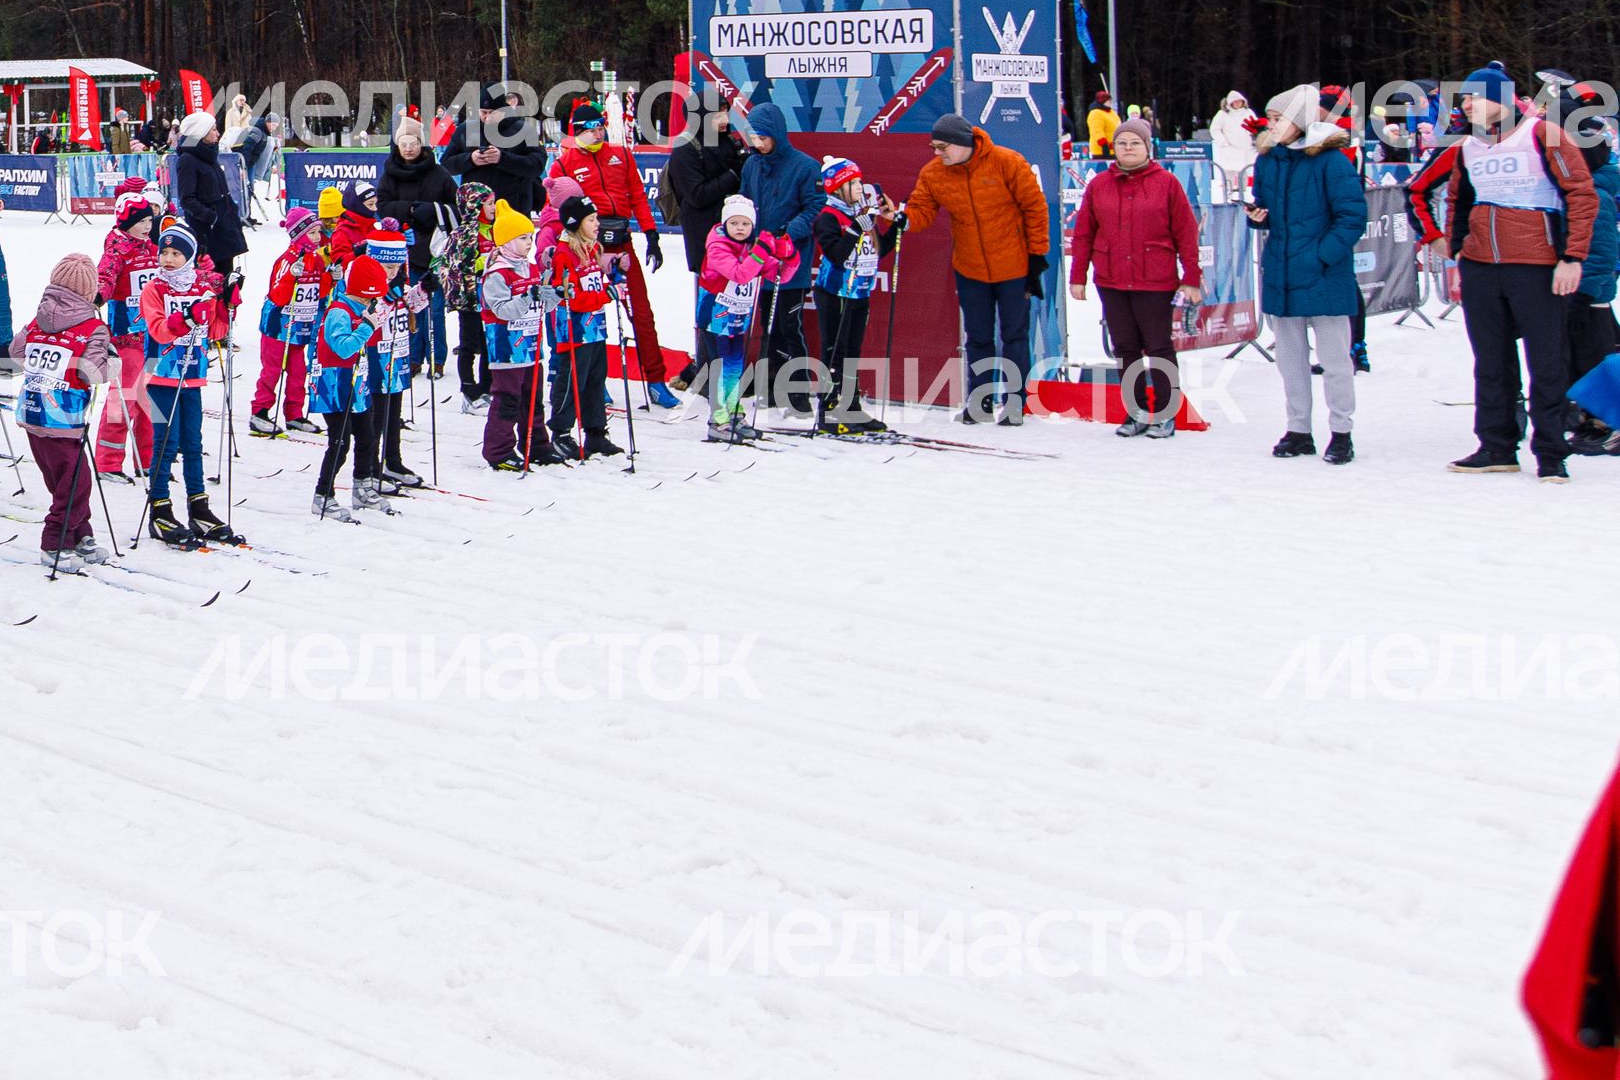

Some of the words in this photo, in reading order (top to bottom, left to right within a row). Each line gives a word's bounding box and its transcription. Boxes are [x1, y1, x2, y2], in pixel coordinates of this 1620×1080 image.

[717, 17, 924, 48] МАНЖОСОВСКАЯ
[787, 57, 848, 74] ЛЫЖНЯ
[975, 58, 1045, 78] МАНЖОСОВСКАЯ
[304, 164, 377, 179] УРАЛХИМ
[14, 185, 41, 196] FACTORY
